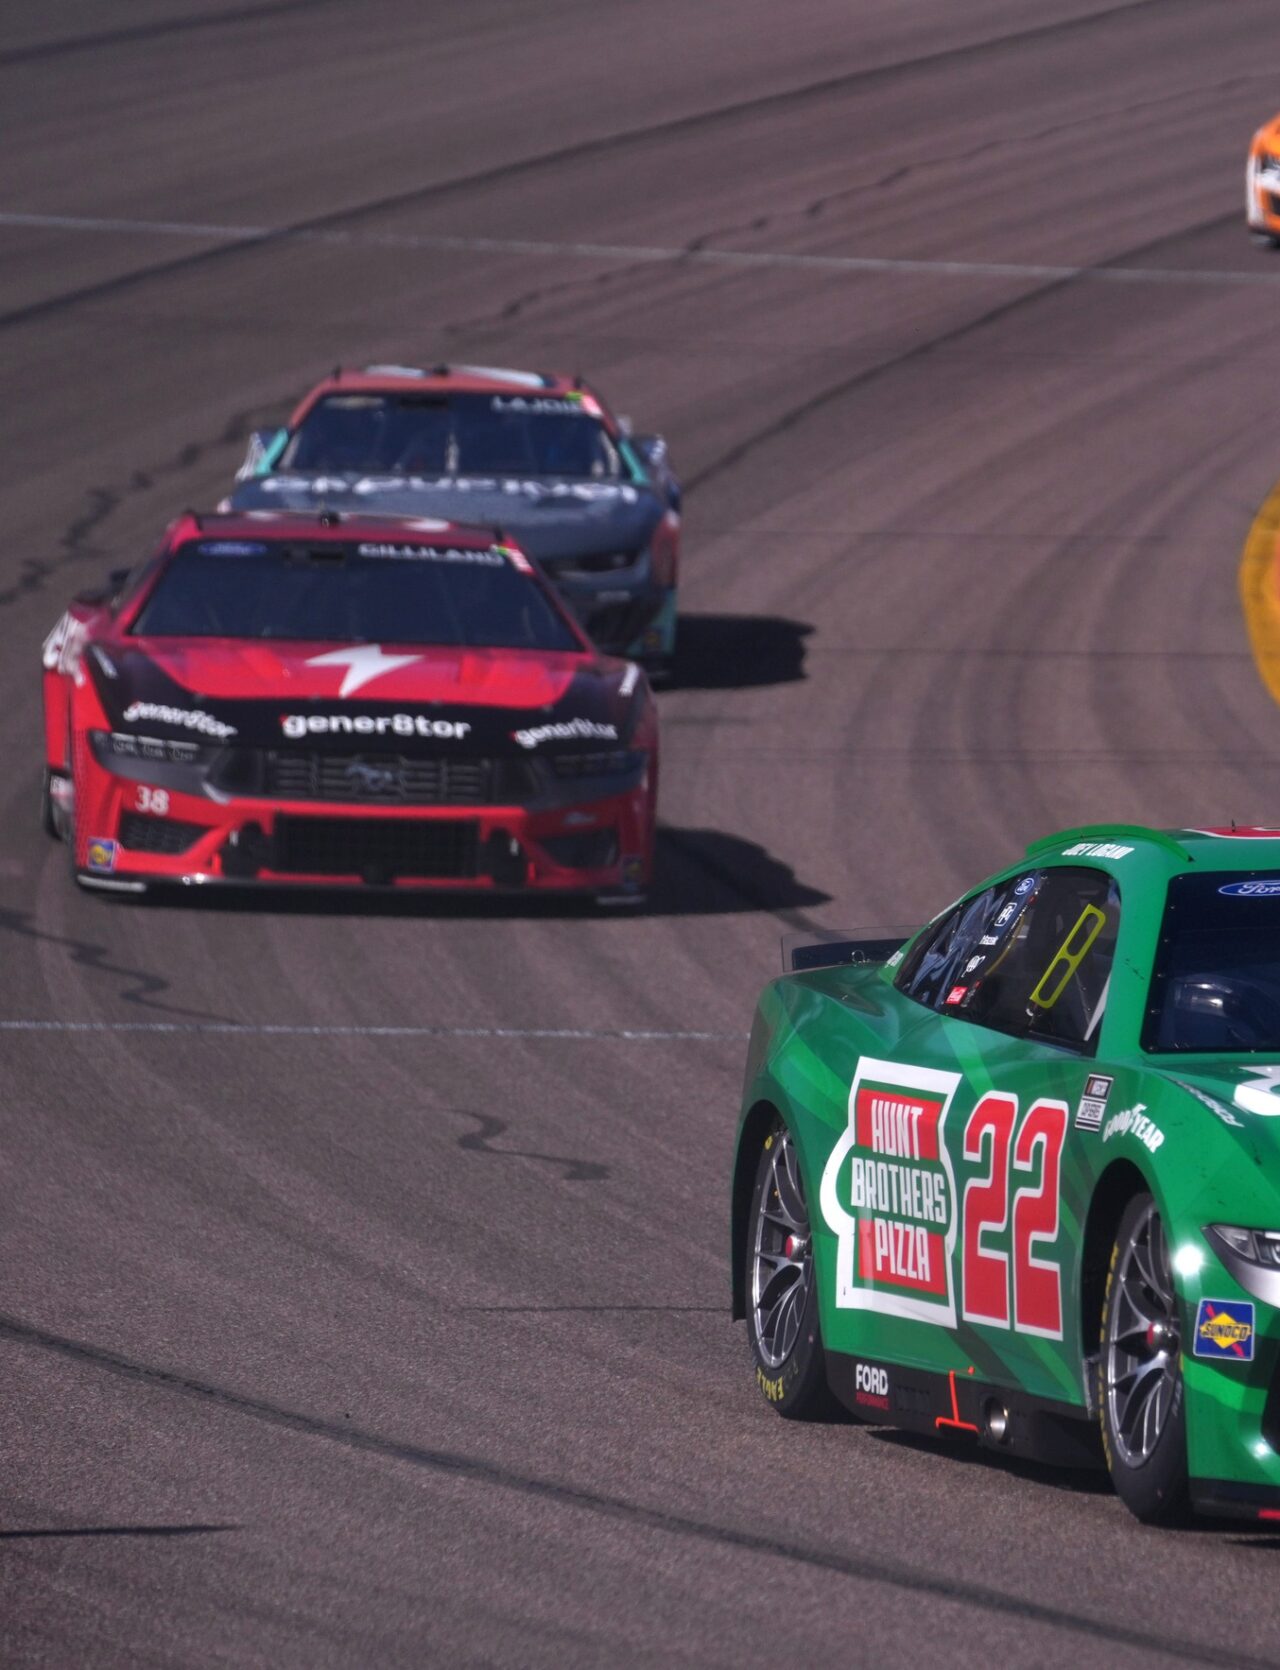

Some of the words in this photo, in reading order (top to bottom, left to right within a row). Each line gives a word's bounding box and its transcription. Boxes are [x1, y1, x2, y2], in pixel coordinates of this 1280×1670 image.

[357, 543, 505, 566] GILLILAND
[280, 712, 471, 740] gener8tor
[513, 717, 619, 749] gener8tor
[135, 785, 170, 816] 38
[871, 1098, 923, 1161] HUNT
[1103, 1103, 1165, 1153] GOODYEAR
[851, 1157, 946, 1224] BROTHERS
[962, 1091, 1068, 1341] 22
[875, 1217, 931, 1282] PIZZA
[1200, 1321, 1253, 1342] SUNOCO
[756, 1367, 785, 1402] EAGLE
[855, 1363, 889, 1396] FORD
